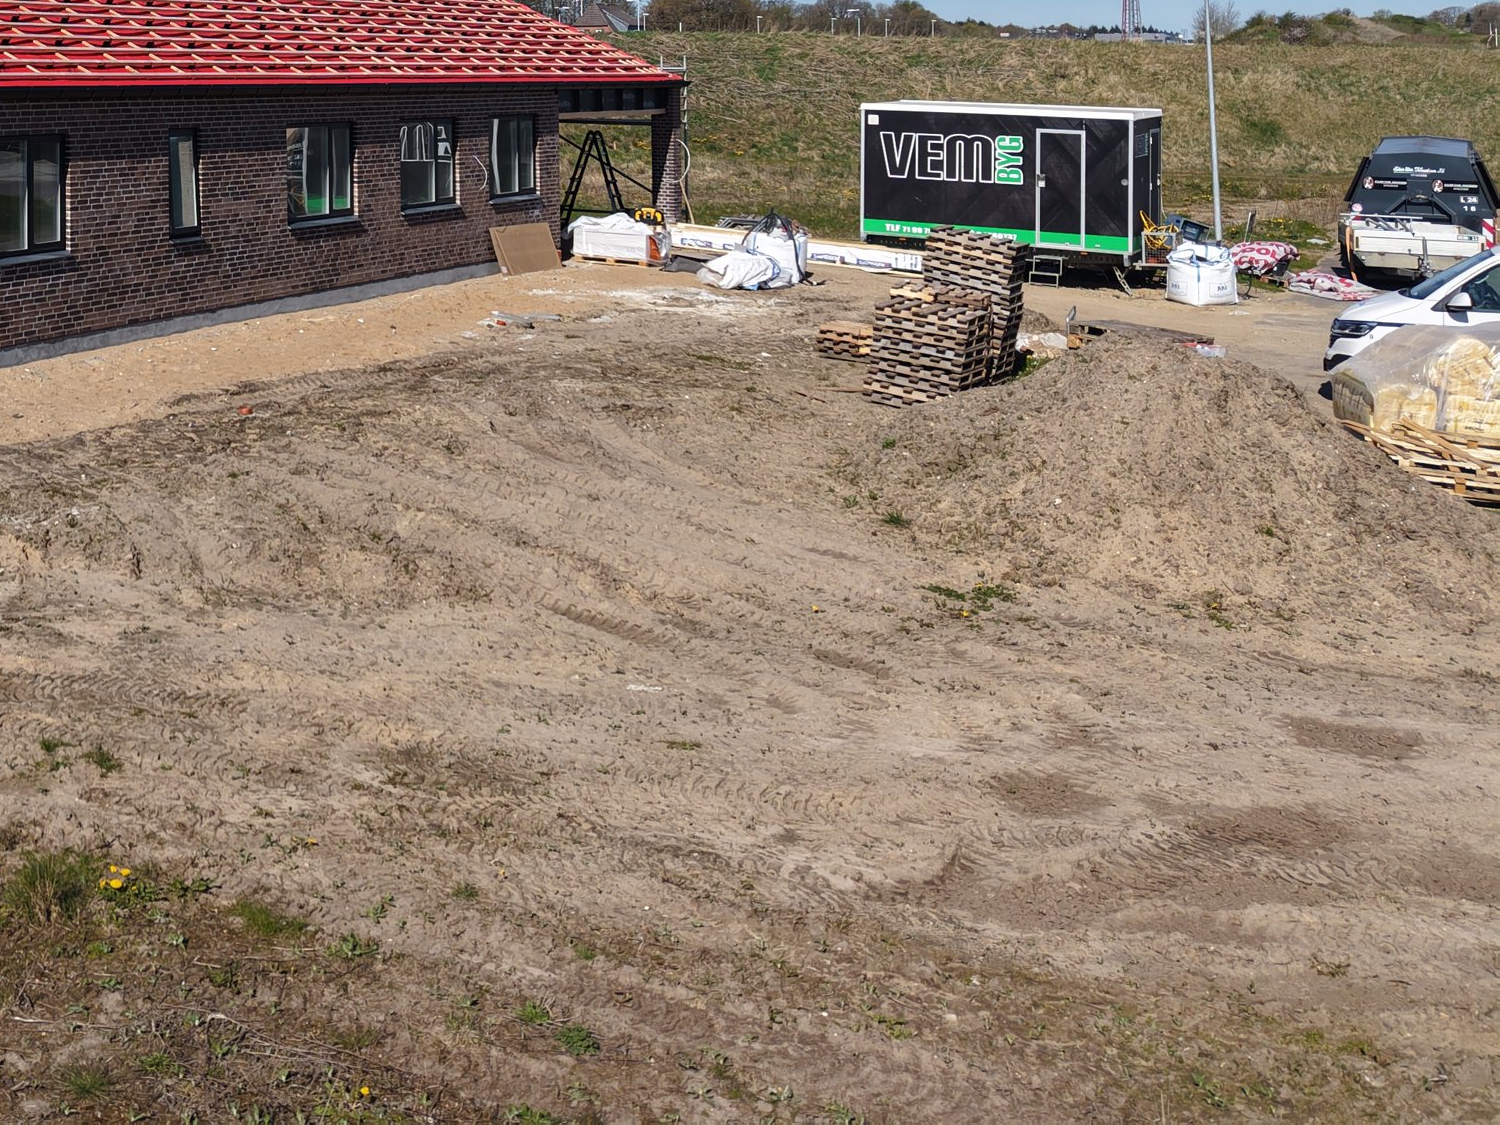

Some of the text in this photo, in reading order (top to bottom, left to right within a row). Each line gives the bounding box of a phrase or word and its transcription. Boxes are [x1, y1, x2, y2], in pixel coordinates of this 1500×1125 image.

[880, 131, 1024, 185] VEM BYG
[885, 223, 901, 233] TLF
